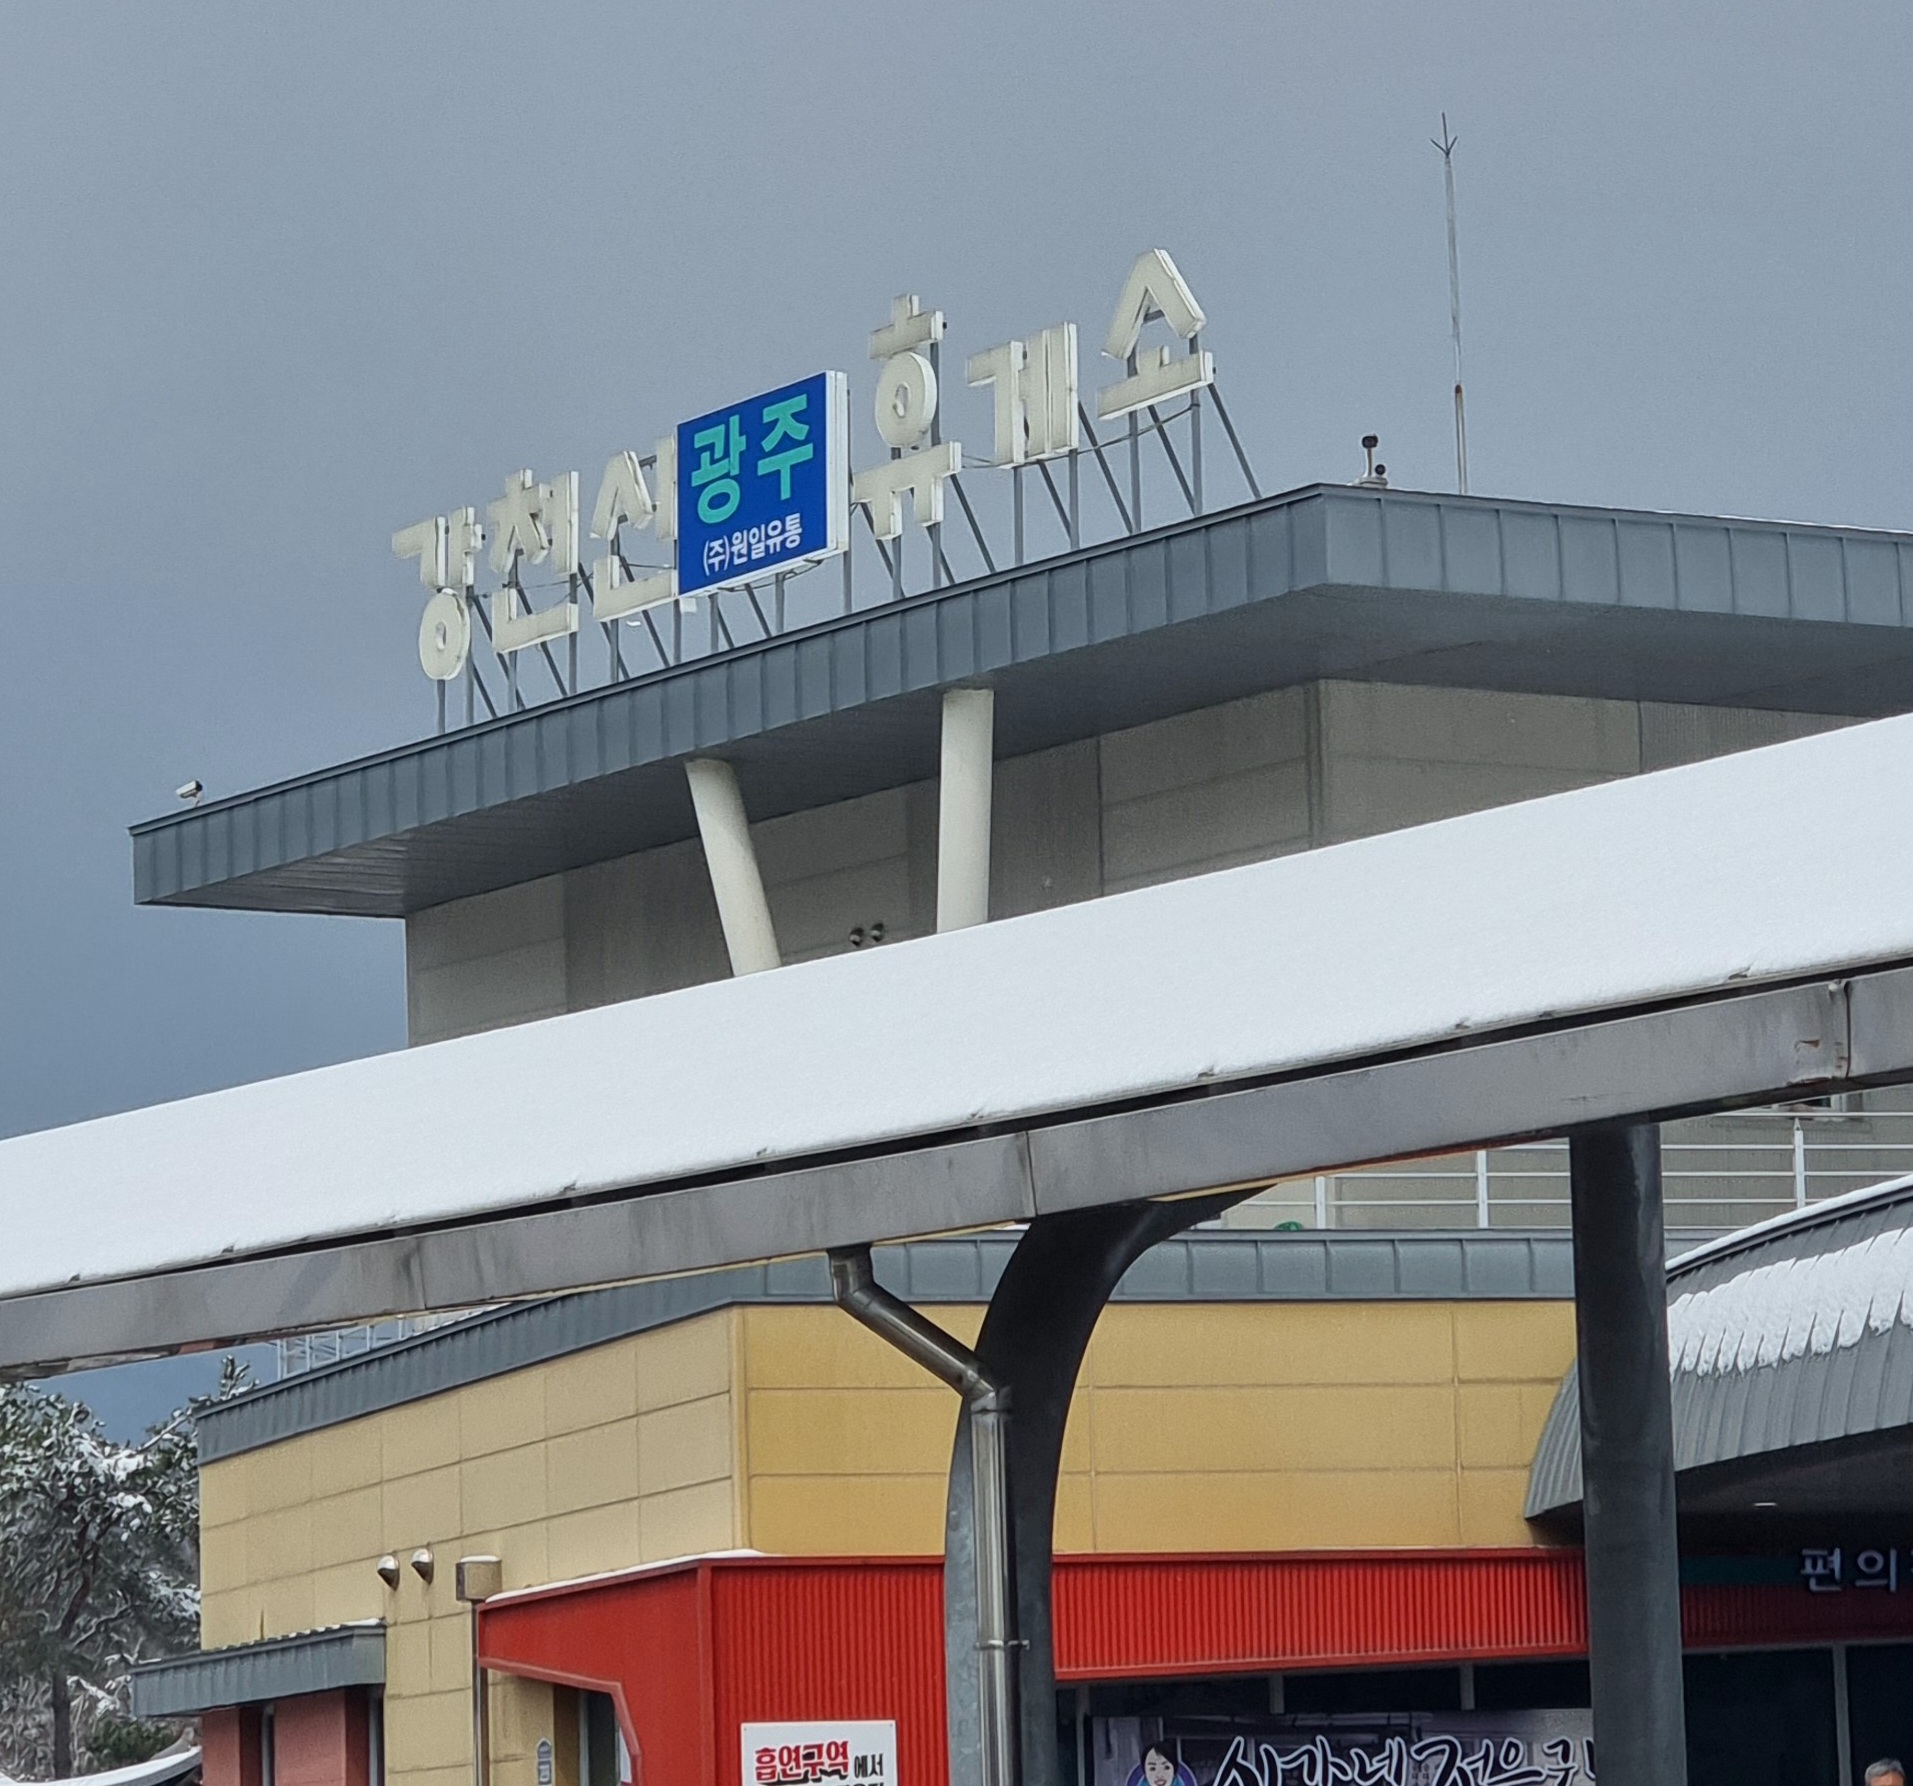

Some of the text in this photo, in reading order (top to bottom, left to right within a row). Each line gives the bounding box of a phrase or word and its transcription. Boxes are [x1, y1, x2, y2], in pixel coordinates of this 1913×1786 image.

[391, 248, 1215, 682] 강천산 휴게소
[691, 393, 814, 525] 광주
[703, 513, 802, 577] (주)원일유통
[1800, 1546, 1913, 1593] 편의
[755, 1740, 849, 1782] 흡연구역
